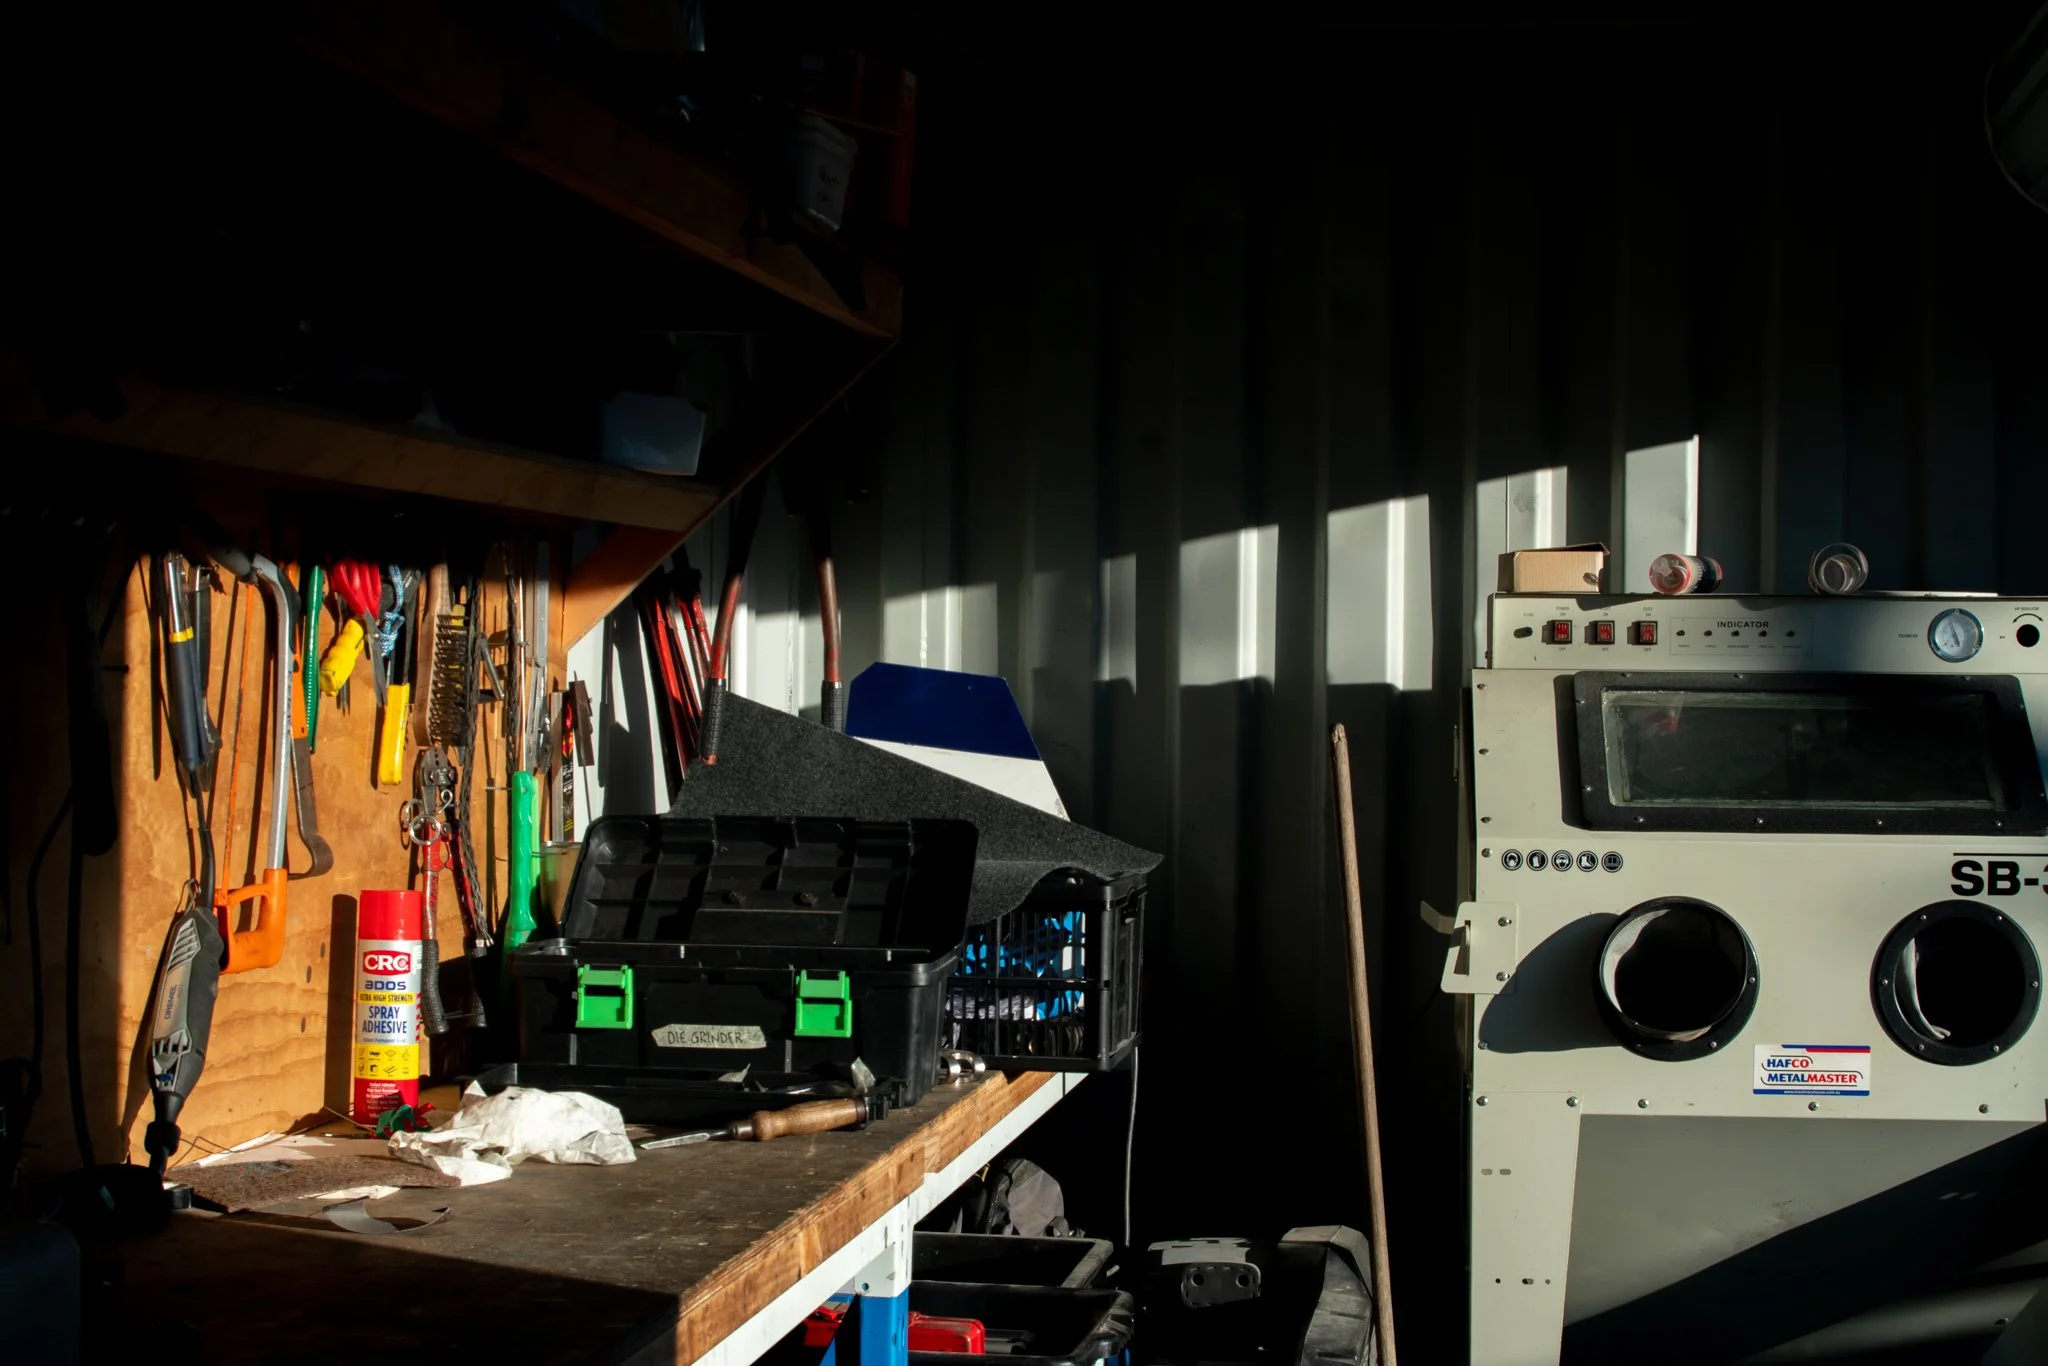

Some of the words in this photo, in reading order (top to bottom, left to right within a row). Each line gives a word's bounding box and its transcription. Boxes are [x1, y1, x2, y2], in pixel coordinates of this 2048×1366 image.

[1951, 860, 2048, 896] SB-
[364, 954, 409, 971] CRC
[165, 985, 177, 1019] DREMEL
[373, 994, 387, 1002] HIGH
[388, 994, 413, 1002] STRENGTH
[369, 1006, 400, 1019] SPRAY
[362, 1020, 407, 1034] ADHESIVE
[667, 1031, 685, 1044] DIE
[691, 1031, 743, 1044] GRINDER
[1767, 1059, 1809, 1068] HAFCO
[1767, 1073, 1857, 1083] METALMASTER
